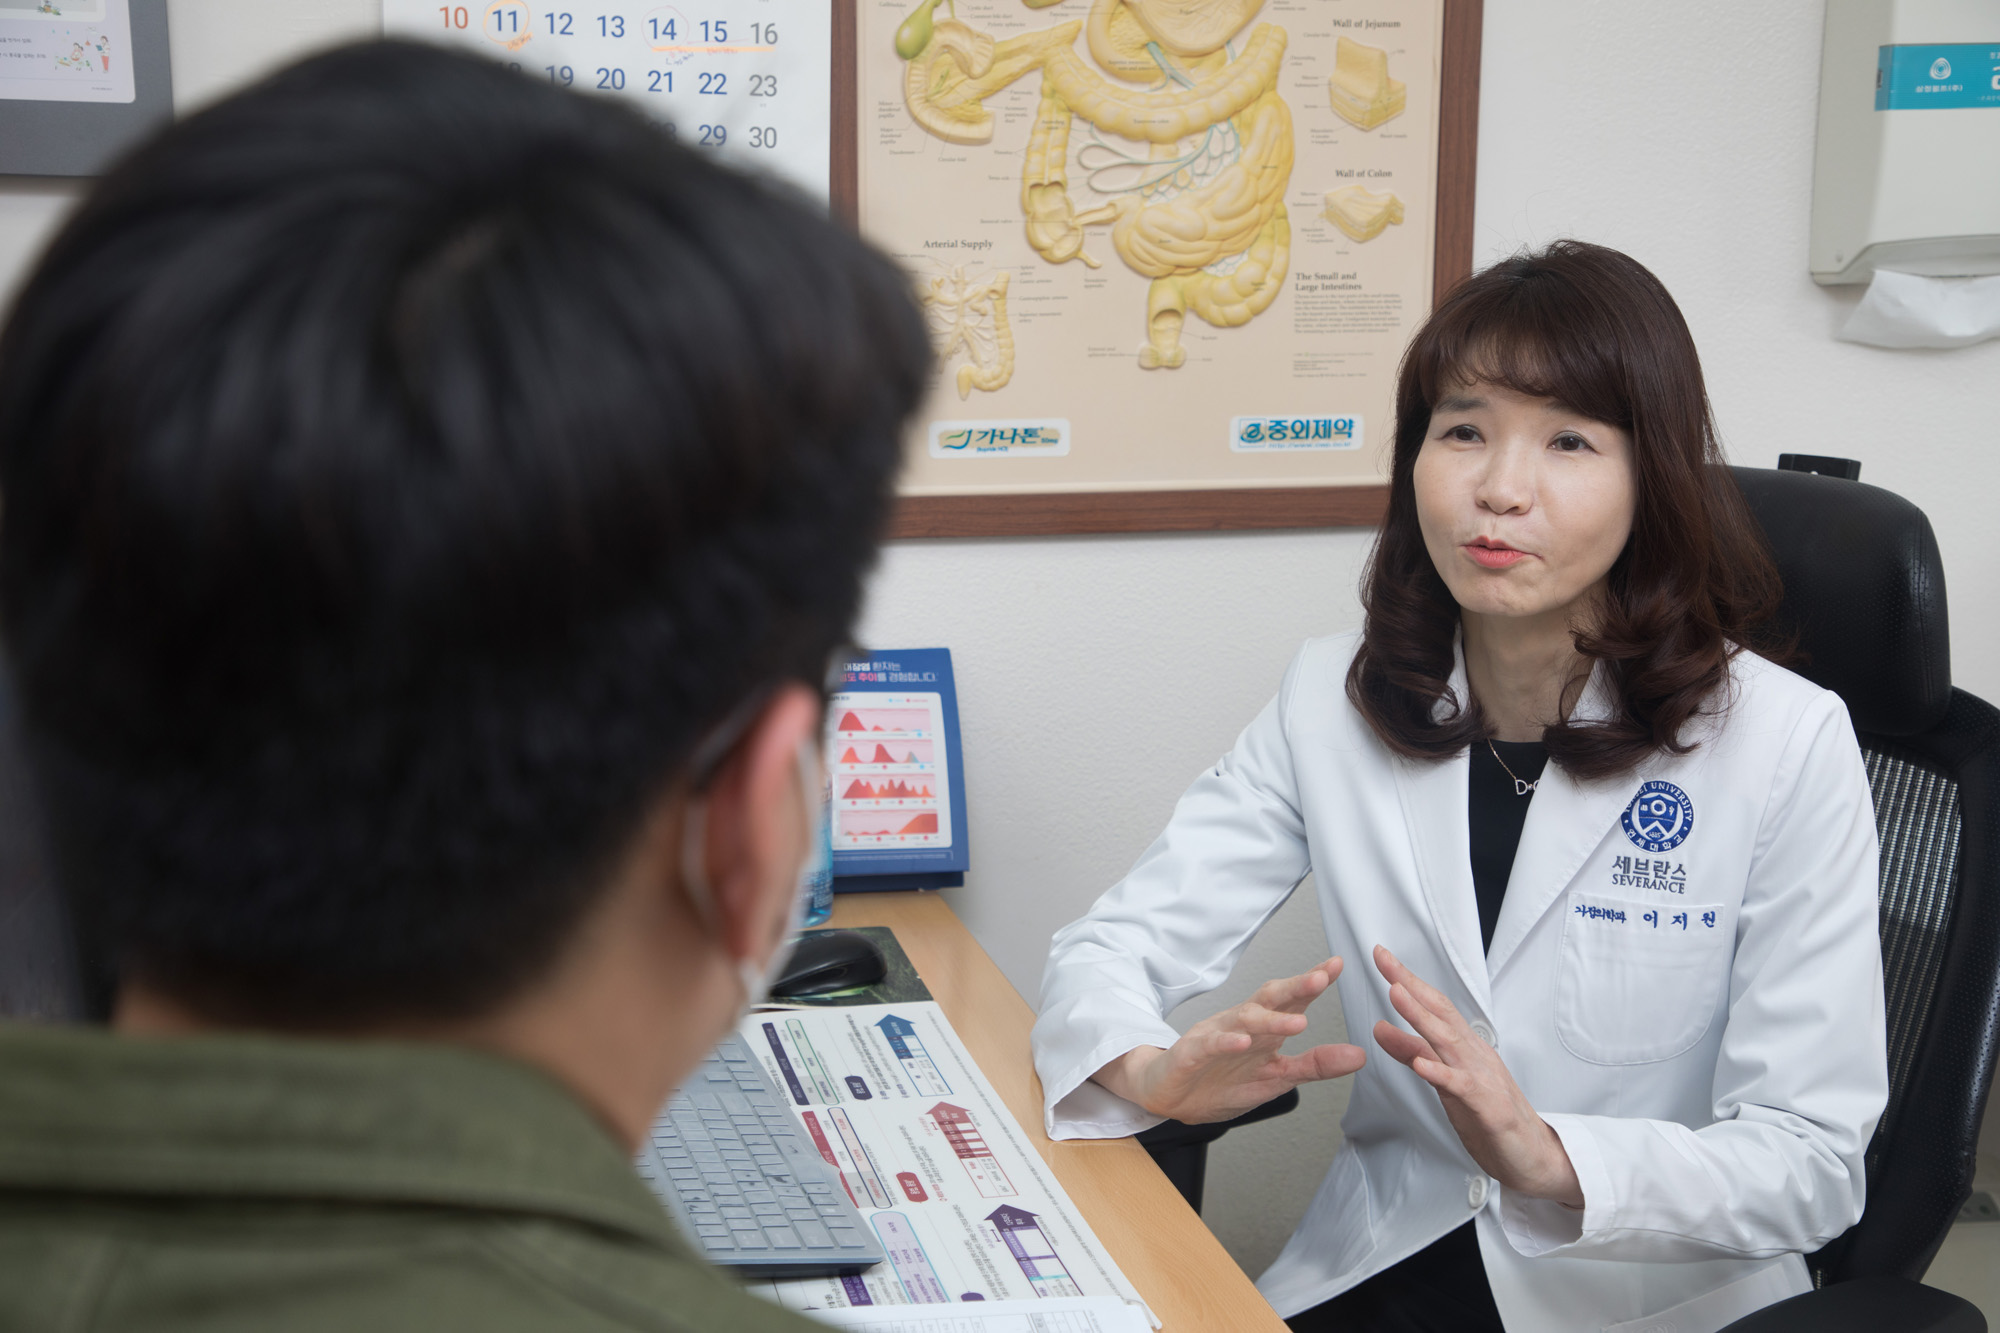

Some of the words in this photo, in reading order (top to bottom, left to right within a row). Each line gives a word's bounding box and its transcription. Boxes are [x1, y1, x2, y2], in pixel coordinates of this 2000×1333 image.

[440, 7, 468, 29] 10
[492, 9, 517, 32] 11
[545, 12, 574, 35] 12
[597, 16, 625, 38] 13
[649, 18, 677, 40] 14
[700, 20, 727, 43] 15
[750, 23, 778, 45] 16
[1333, 19, 1352, 28] Wall
[1354, 19, 1363, 28] of
[1365, 20, 1401, 29] Jejunum
[596, 68, 625, 90] 20
[648, 70, 673, 93] 21
[699, 73, 727, 95] 22
[749, 75, 777, 97] 23
[699, 125, 727, 147] 29
[749, 127, 777, 148] 30
[1335, 169, 1354, 177] Wall
[1356, 169, 1365, 177] of
[1367, 169, 1393, 177] Colon
[923, 240, 958, 248] Arterial
[960, 240, 993, 250] Supply
[1296, 272, 1312, 280] The
[1314, 272, 1339, 280] Small
[1341, 272, 1357, 280] and
[1295, 283, 1318, 292] Large
[1321, 282, 1362, 291] Intestines
[1268, 418, 1355, 440] 중외제약
[1650, 782, 1692, 821] UNIVERSITY
[1612, 855, 1687, 882] 세브란스
[1611, 874, 1685, 894] SEVERANCE
[1574, 904, 1627, 923] 가정의학과
